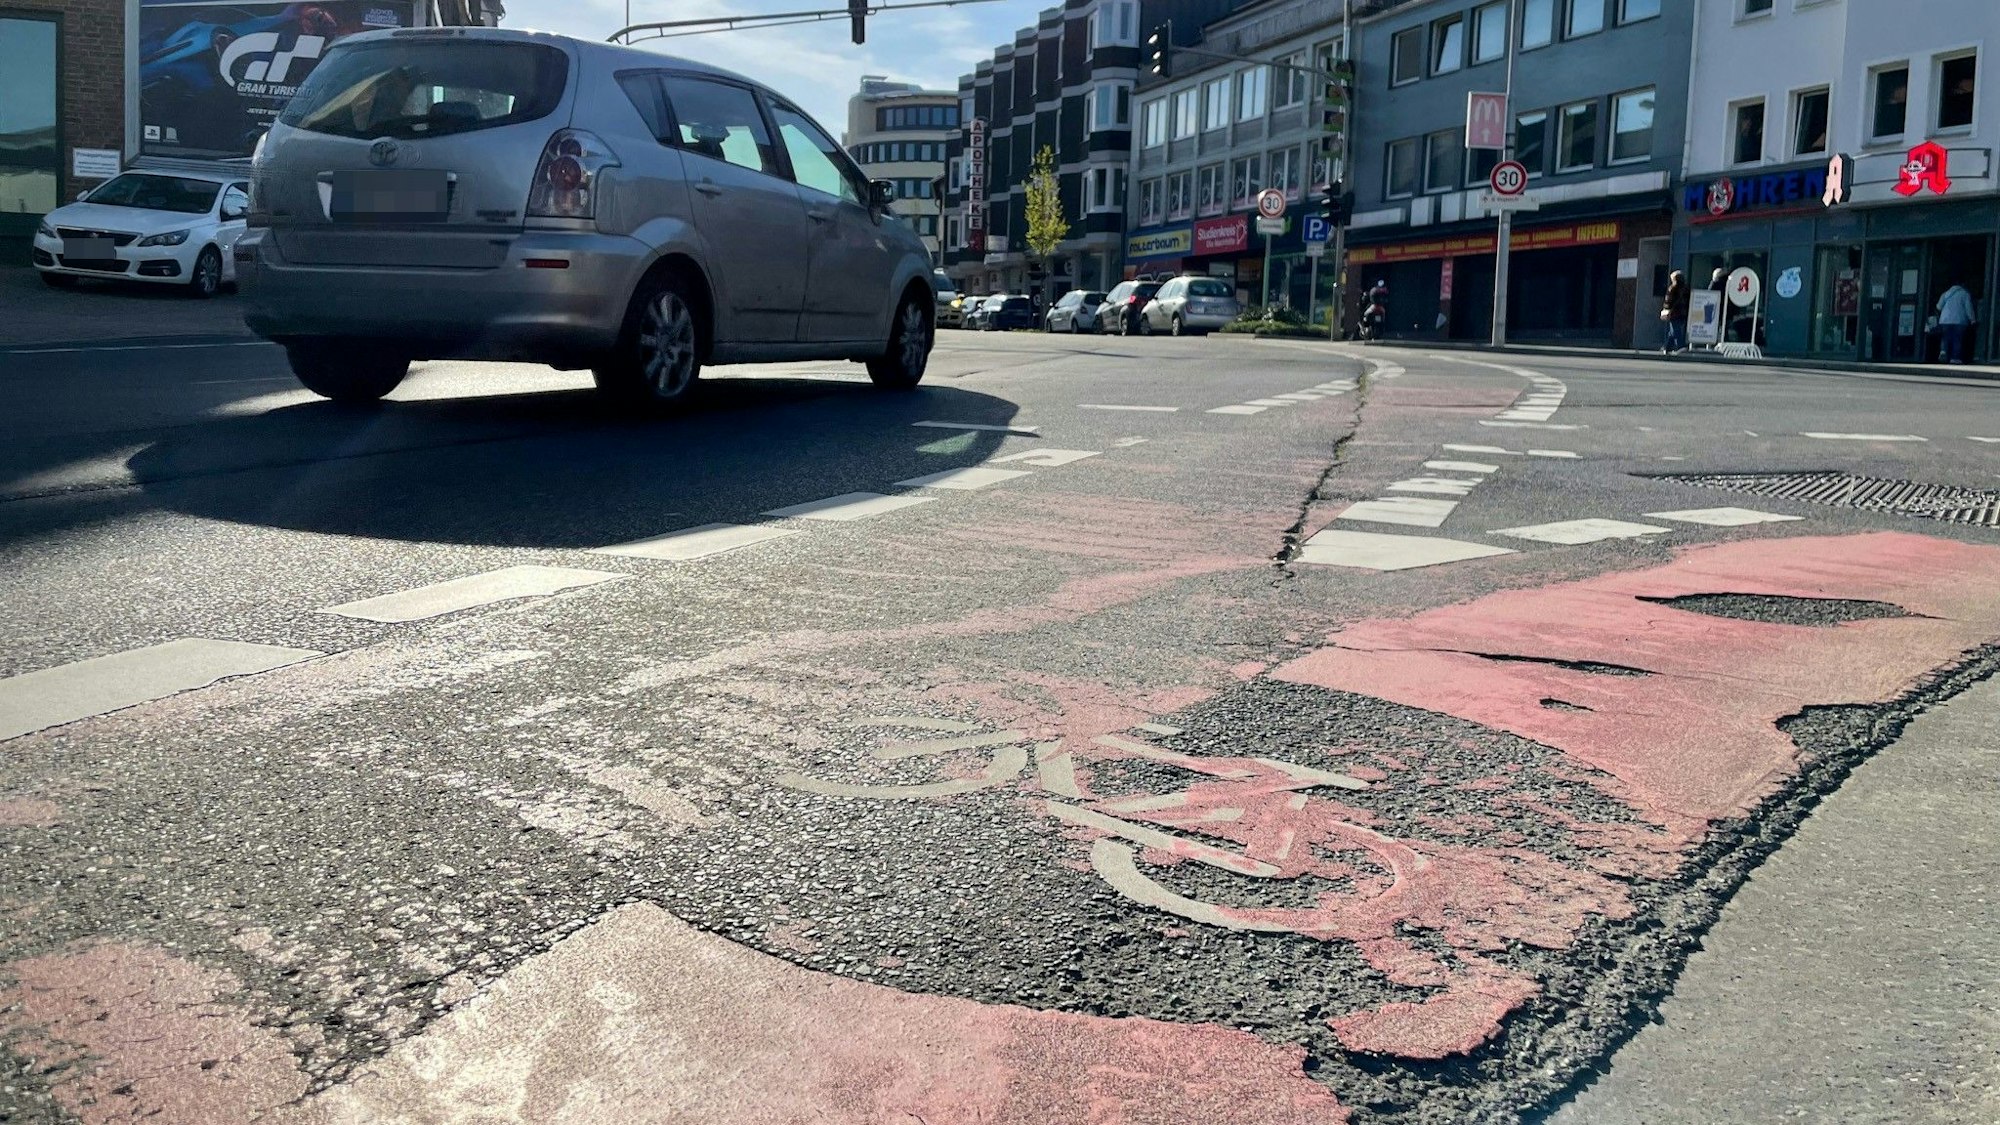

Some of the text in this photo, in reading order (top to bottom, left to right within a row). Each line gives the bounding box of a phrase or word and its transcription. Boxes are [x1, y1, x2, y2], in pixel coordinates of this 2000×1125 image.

[236, 81, 267, 95] GRAN
[971, 121, 983, 229] APOTHEKE
[1497, 170, 1519, 187] 30
[1265, 196, 1280, 211] 30
[1309, 219, 1323, 239] P
[1576, 222, 1617, 242] INFERNO
